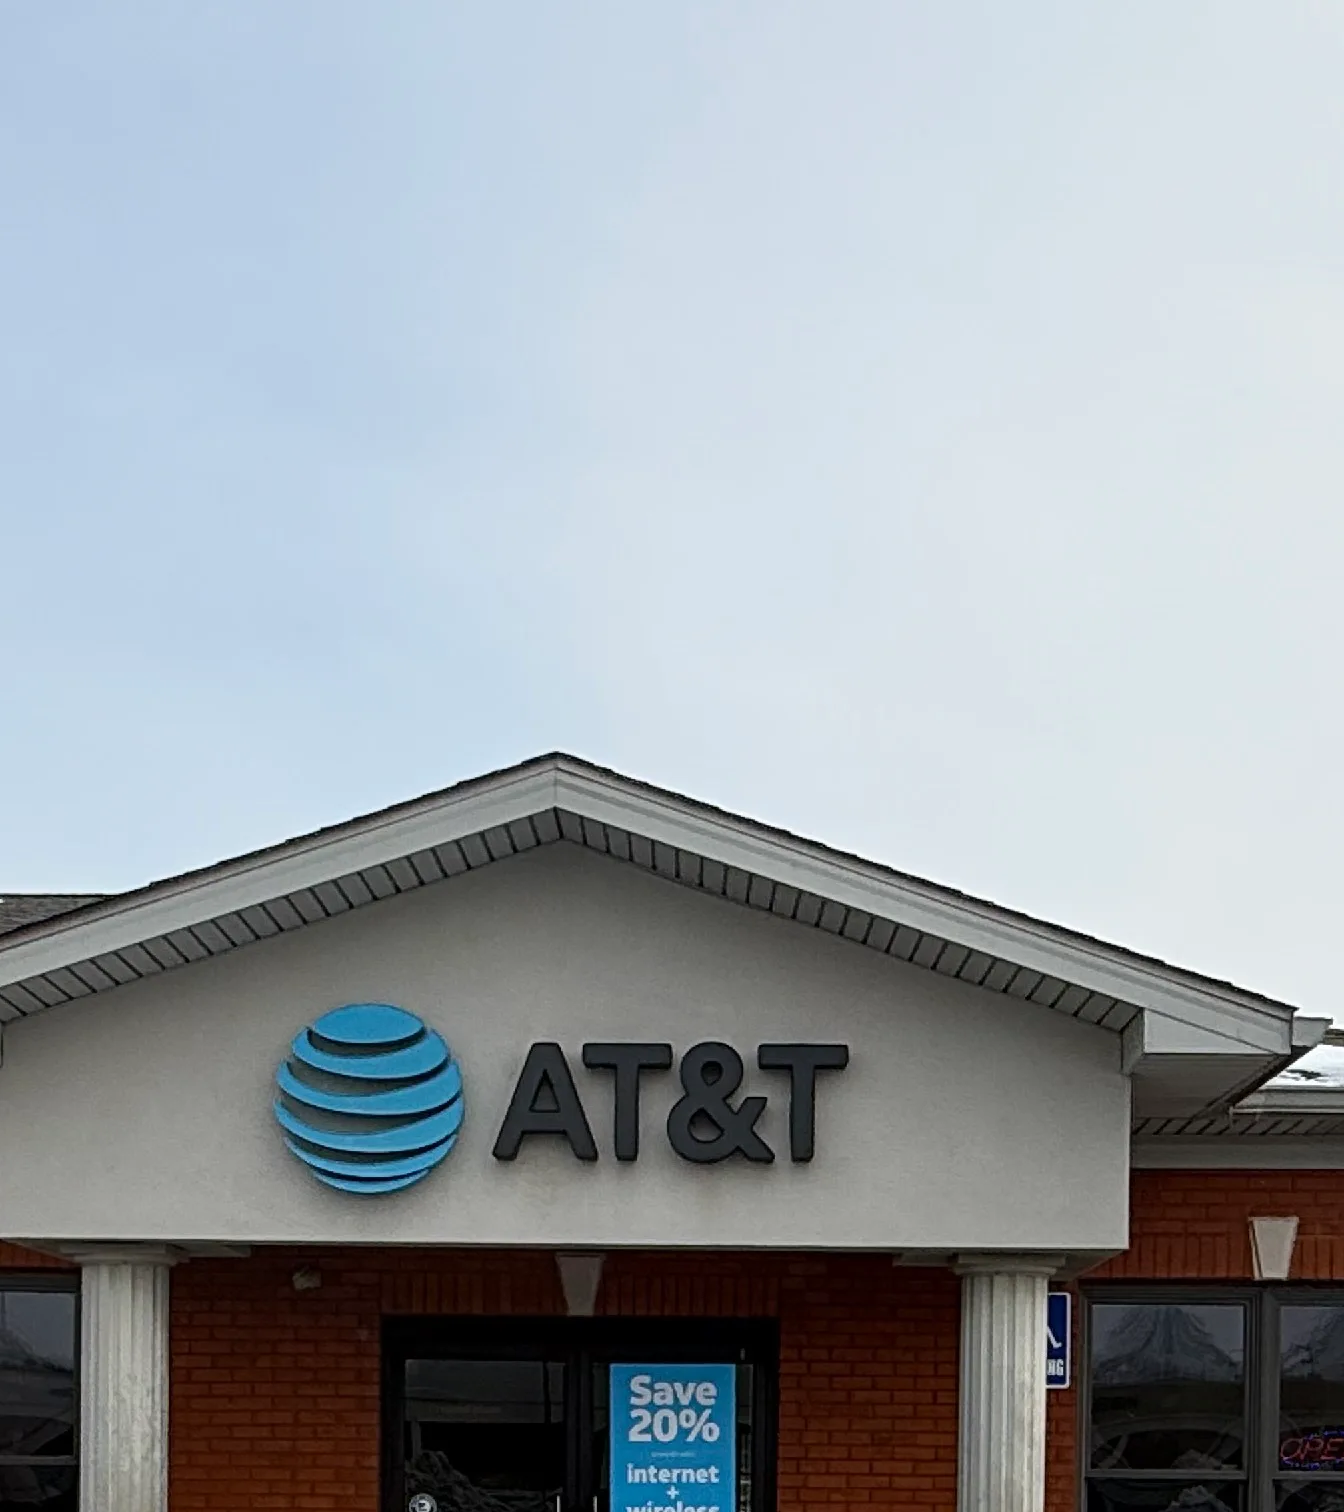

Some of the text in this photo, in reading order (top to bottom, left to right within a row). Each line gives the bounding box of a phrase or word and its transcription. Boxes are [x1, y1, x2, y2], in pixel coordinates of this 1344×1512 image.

[492, 1041, 849, 1164] AT&T
[630, 1375, 718, 1406] Save
[628, 1408, 721, 1442] 20%
[626, 1463, 720, 1484] internet
